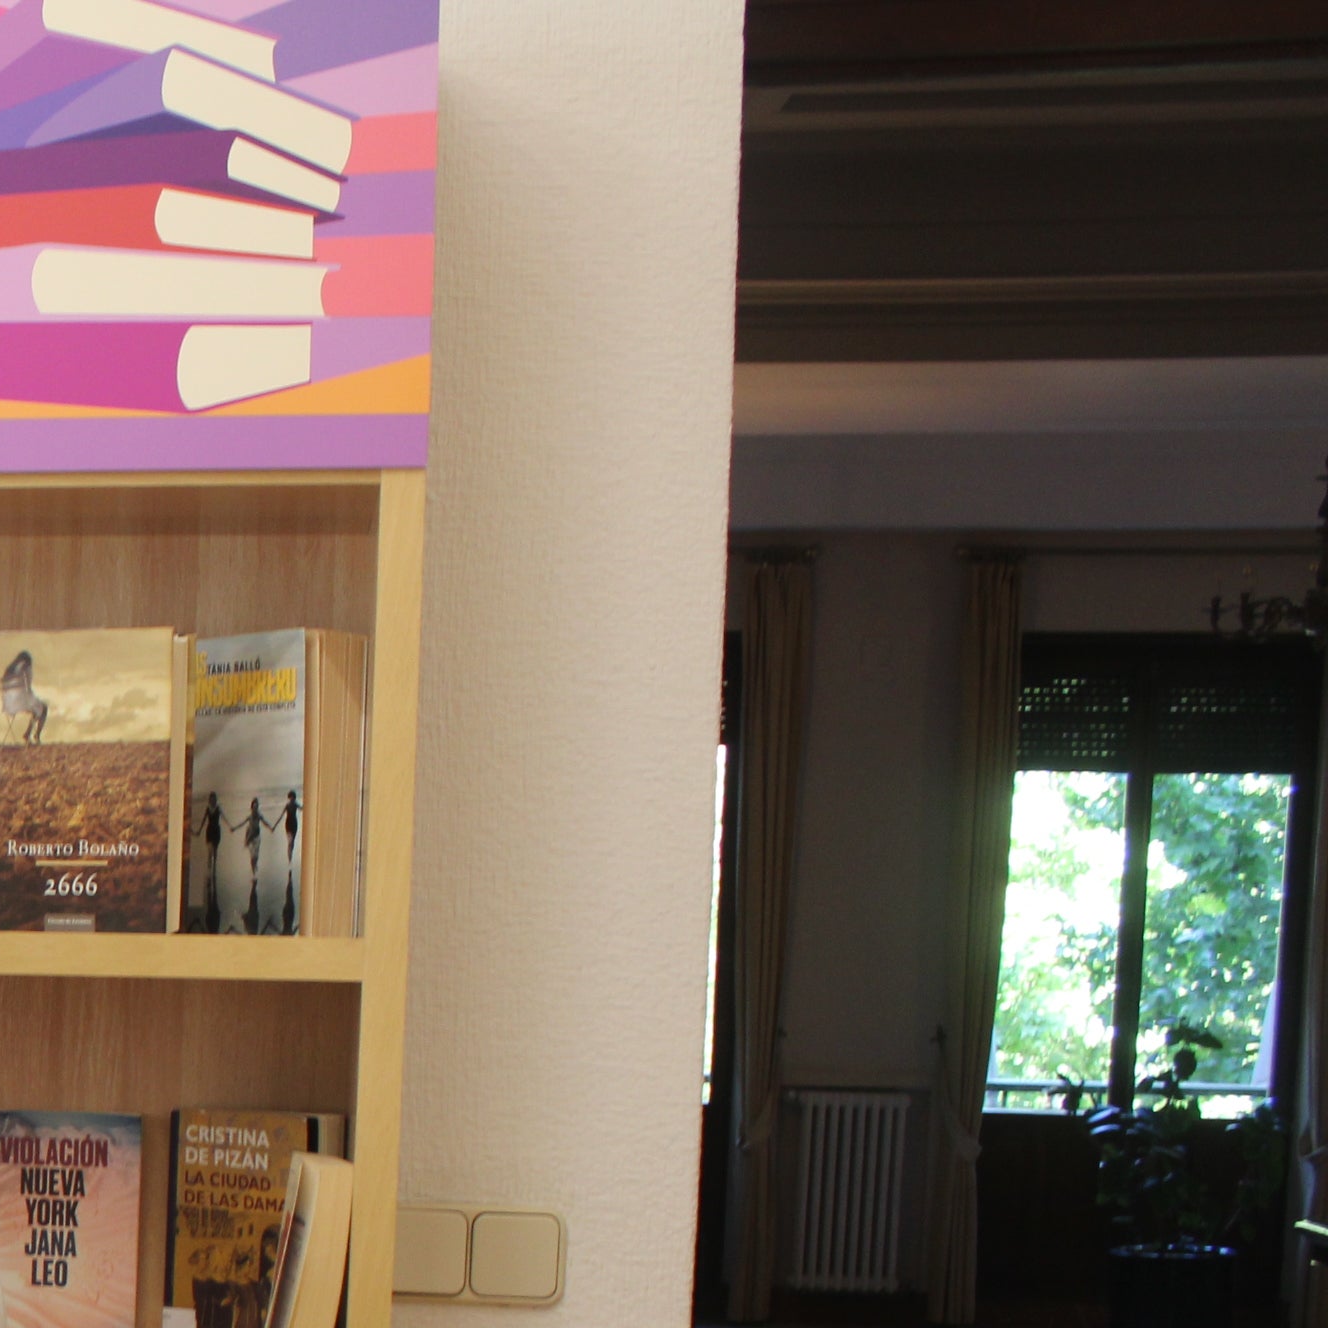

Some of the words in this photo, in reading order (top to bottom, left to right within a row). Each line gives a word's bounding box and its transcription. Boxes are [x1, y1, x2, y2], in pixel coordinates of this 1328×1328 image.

[44, 872, 98, 896] 2666
[0, 1133, 109, 1167] VIOLACIÓN
[185, 1125, 270, 1149] CRISTINA
[185, 1146, 209, 1166] DE
[214, 1148, 269, 1172] PIZÁN
[20, 1168, 86, 1197] NUEVA
[185, 1171, 204, 1185] LA
[210, 1172, 271, 1192] CIUDAD
[25, 1199, 78, 1227] YORK
[184, 1190, 205, 1204] DE
[210, 1192, 239, 1208] LAS
[243, 1195, 285, 1212] DAMA
[24, 1228, 77, 1257] JANA
[31, 1259, 69, 1287] LEO
